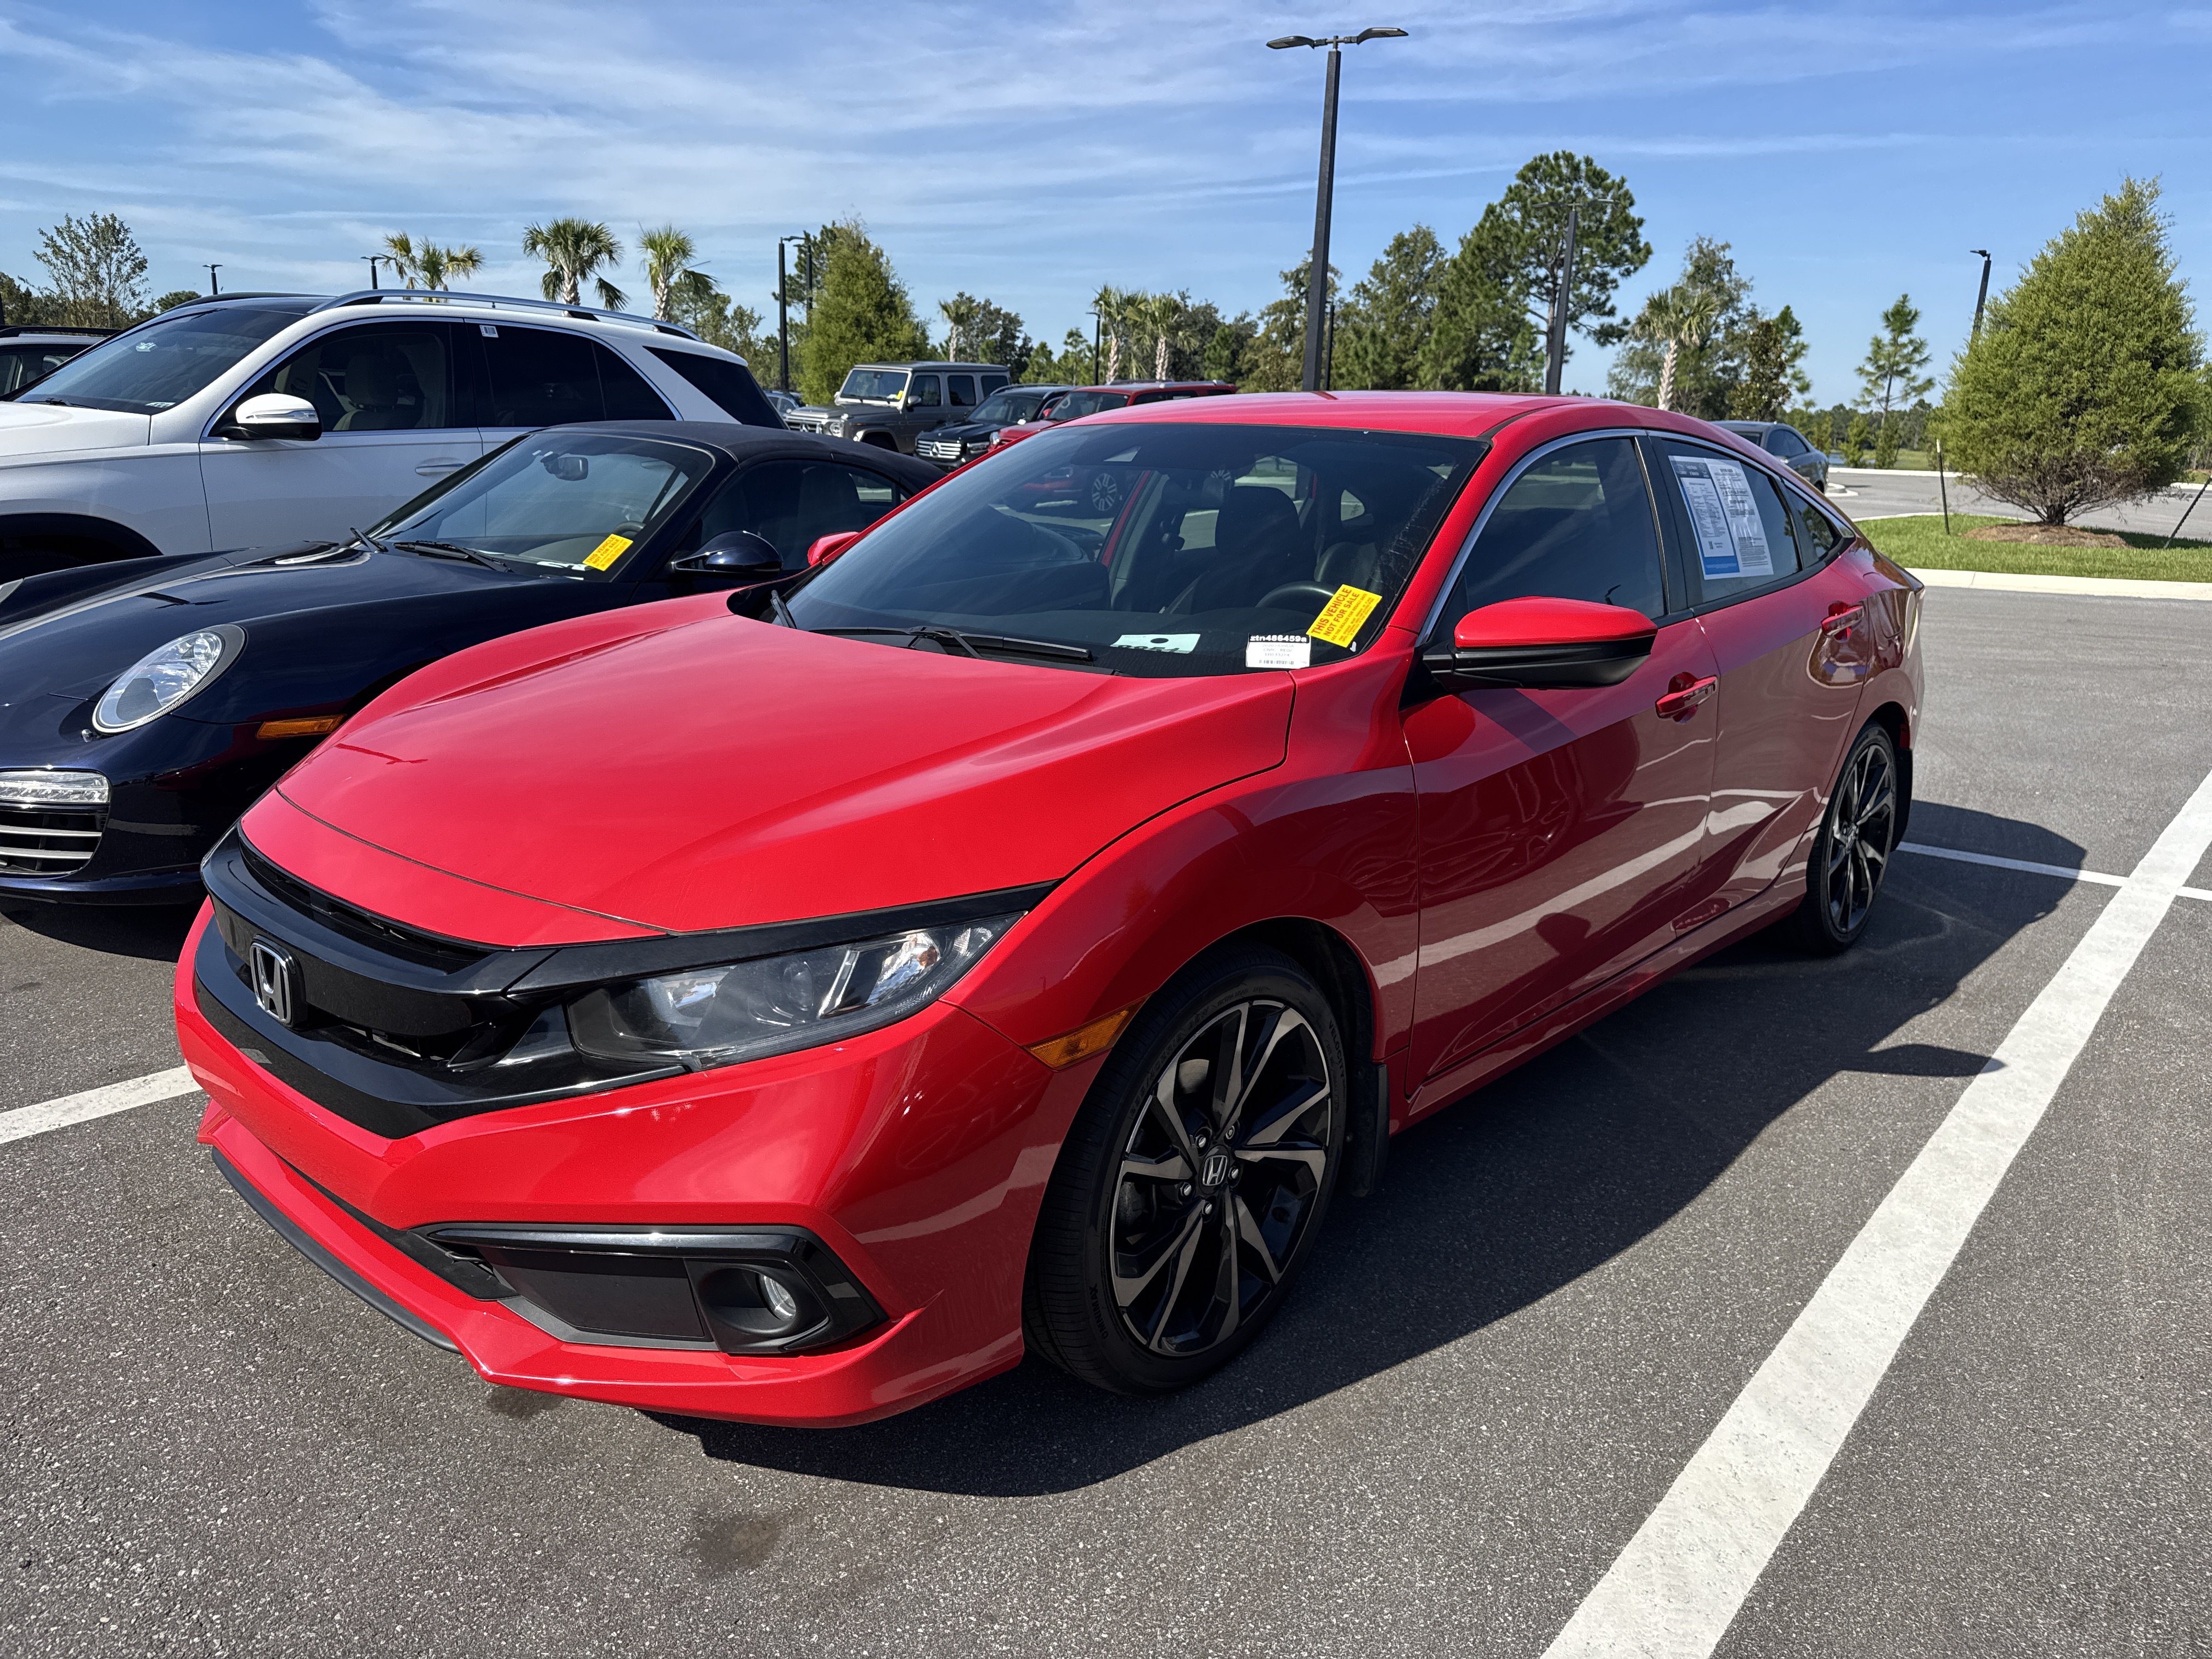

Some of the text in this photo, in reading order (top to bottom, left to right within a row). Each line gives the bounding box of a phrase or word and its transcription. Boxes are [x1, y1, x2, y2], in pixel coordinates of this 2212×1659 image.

[585, 553, 598, 563] THIS
[596, 536, 616, 554] VEHICLE
[592, 539, 619, 564] NOT FOR SALE
[1311, 588, 1352, 634] THIS VEHICLE
[1323, 592, 1359, 636] NOT FOR SALE
[1329, 1020, 1344, 1077] VELOCITY
[1089, 1283, 1108, 1340] OMNIMAX
